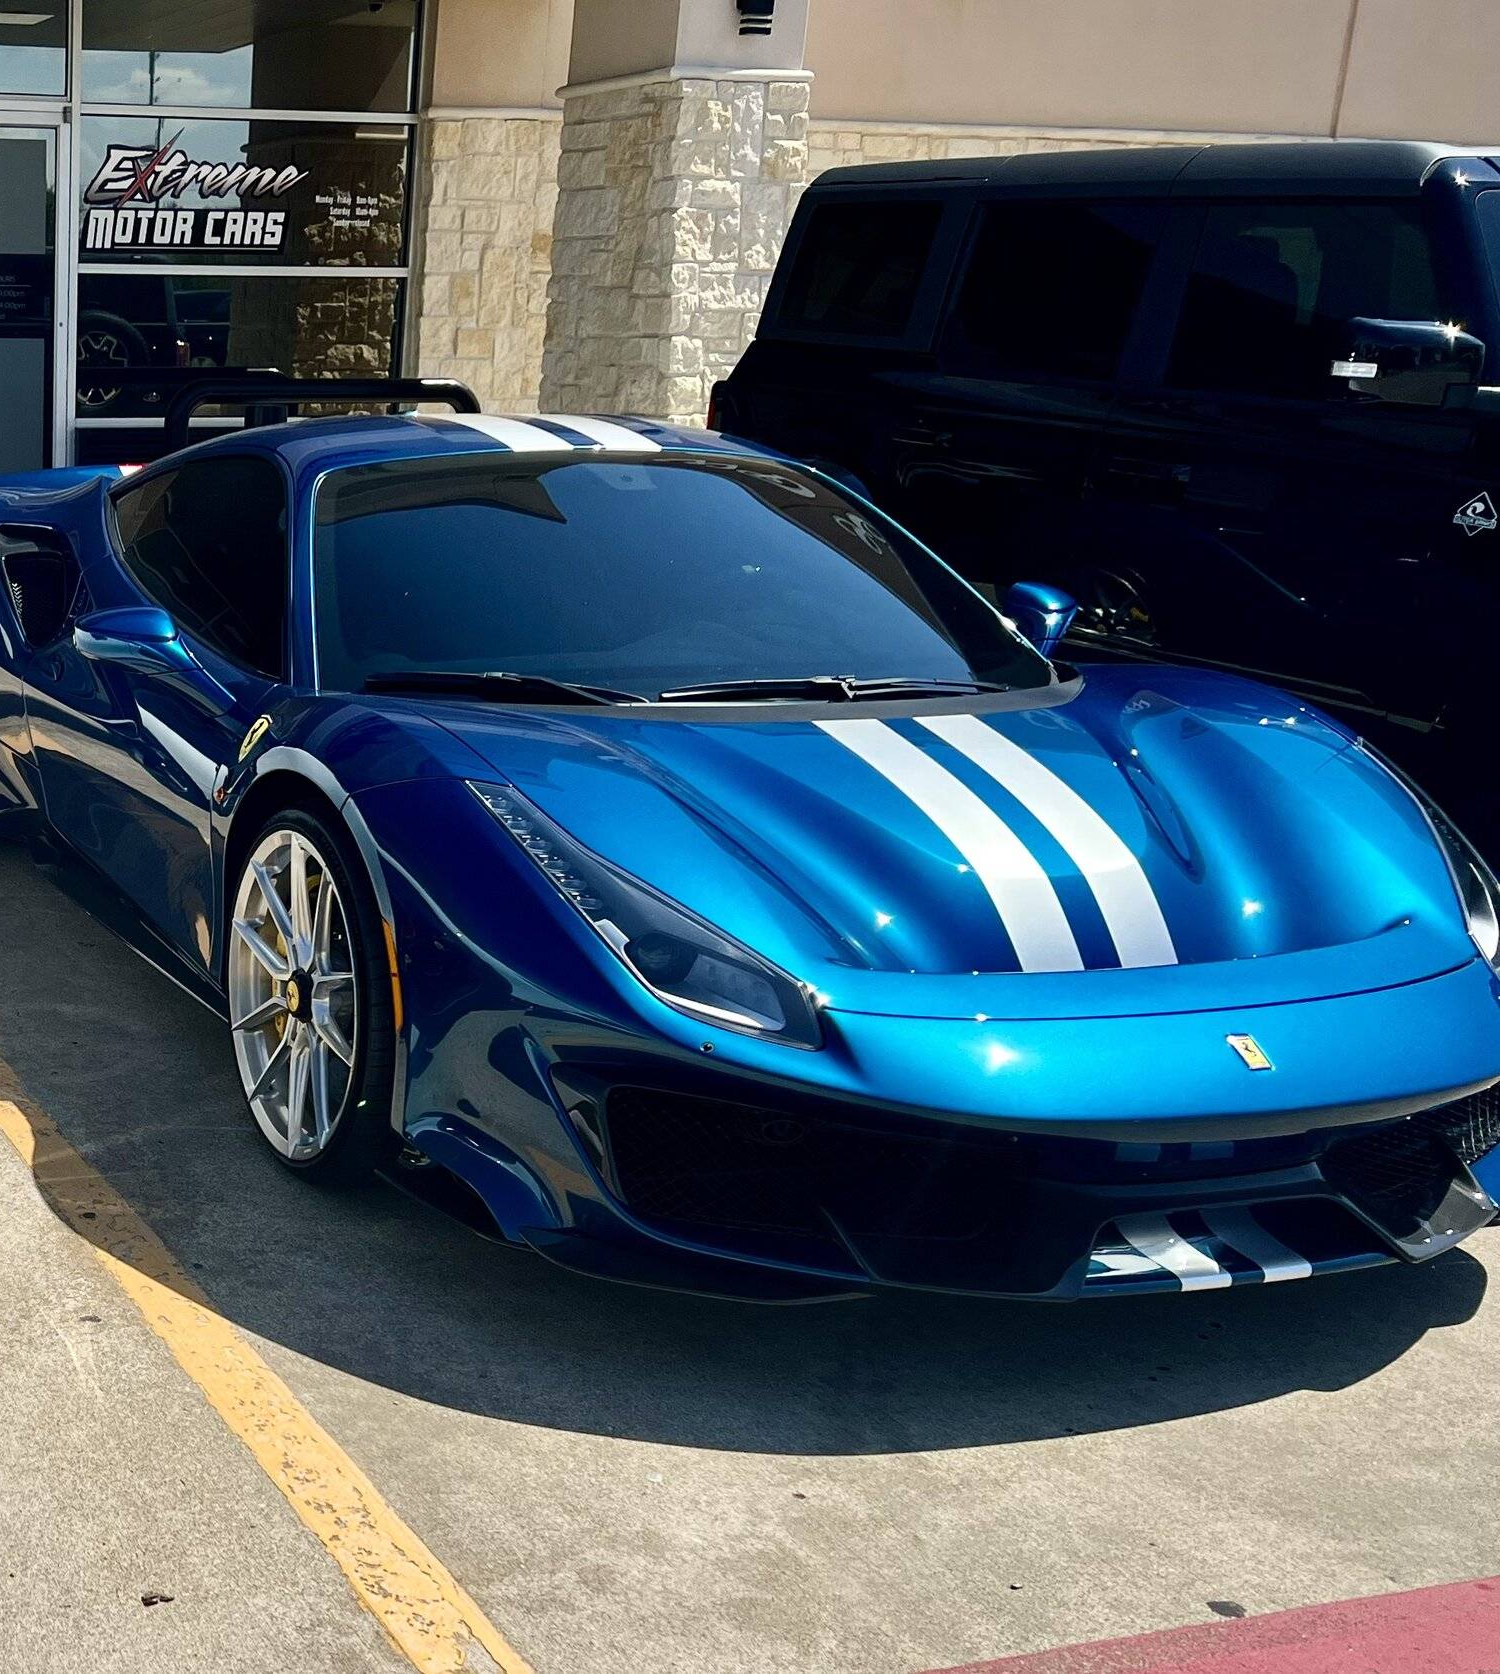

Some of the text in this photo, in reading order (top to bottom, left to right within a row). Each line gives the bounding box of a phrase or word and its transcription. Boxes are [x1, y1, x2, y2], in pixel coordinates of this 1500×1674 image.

[83, 127, 310, 208] Extreme
[86, 209, 285, 249] MOTOR CARS
